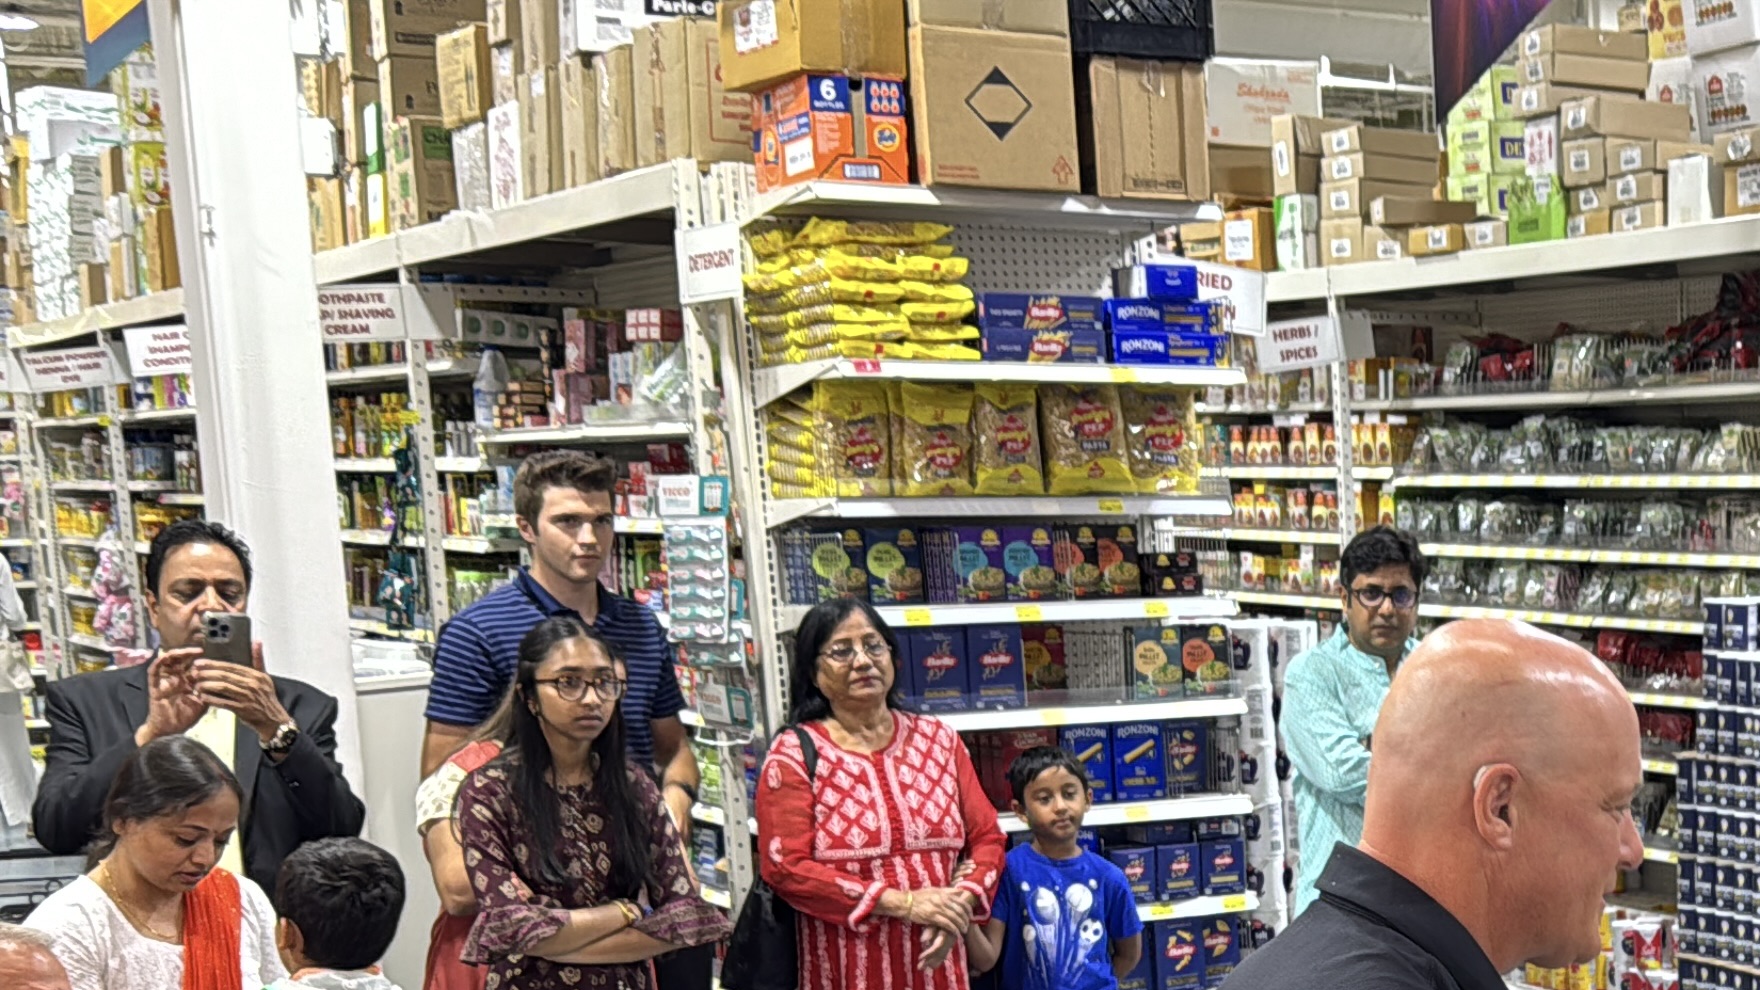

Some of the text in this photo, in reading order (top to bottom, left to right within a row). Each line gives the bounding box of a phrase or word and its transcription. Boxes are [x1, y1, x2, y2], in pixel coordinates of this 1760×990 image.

[819, 79, 837, 100] 6
[318, 292, 386, 305] OTHPASTE
[1117, 304, 1161, 321] RONZONI
[324, 322, 371, 335] CREAM
[1272, 324, 1312, 343] HERBS
[1120, 338, 1166, 354] RONZONI
[1279, 345, 1318, 362] SPICES
[1064, 728, 1108, 740] RONZONI
[1117, 724, 1159, 739] RONZONI
